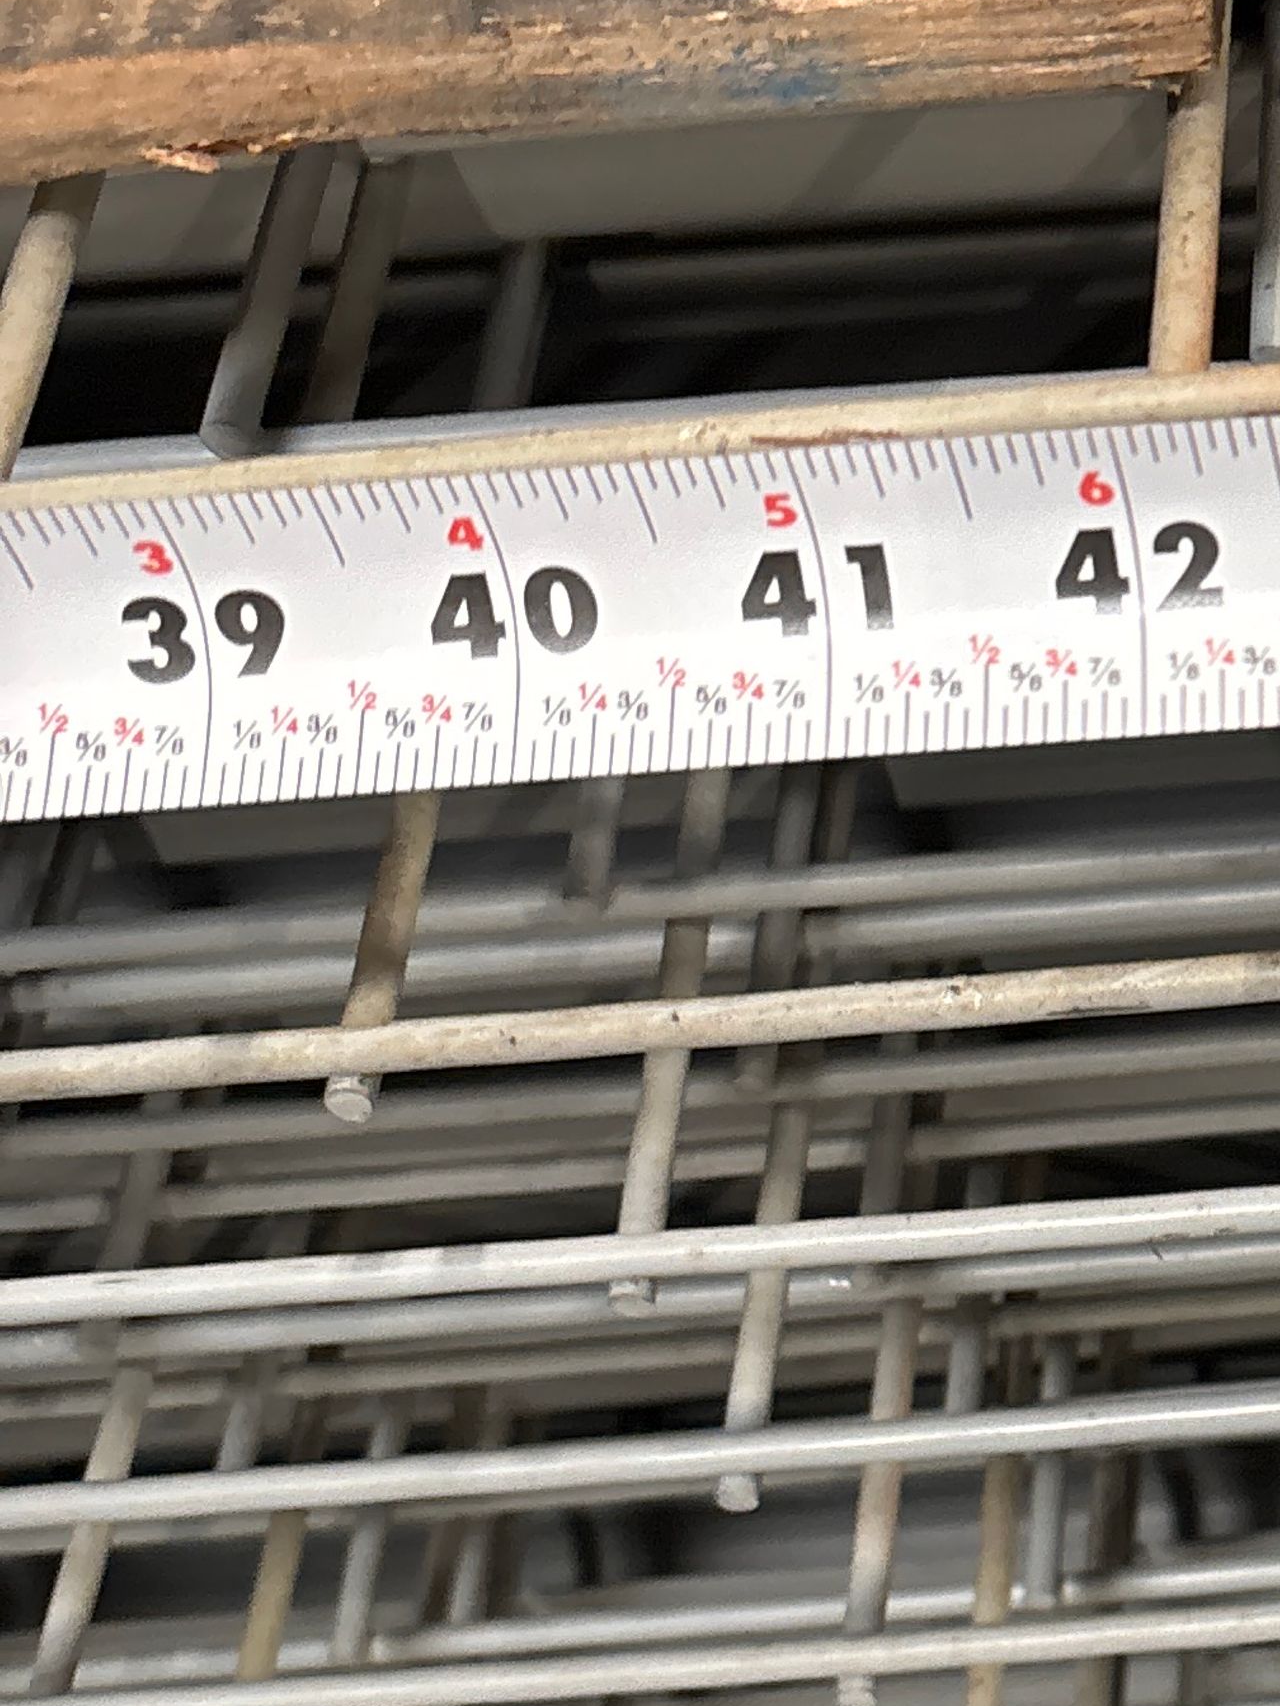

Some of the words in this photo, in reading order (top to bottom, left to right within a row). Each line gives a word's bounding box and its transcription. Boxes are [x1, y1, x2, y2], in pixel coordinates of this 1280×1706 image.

[131, 540, 174, 575] 3
[447, 516, 485, 552] 4
[763, 492, 798, 528] 5
[1078, 470, 1116, 507] 6
[120, 589, 286, 684] 39
[429, 565, 599, 660] 40
[741, 543, 895, 638] 41
[1054, 521, 1226, 615] 42
[37, 703, 70, 736] 1/2
[113, 716, 146, 748] 3/4
[270, 706, 299, 737] 1/4
[347, 679, 378, 710] 1/2
[420, 693, 453, 724] 3/4
[578, 683, 608, 712] 1/4
[655, 657, 687, 688] 1/2
[730, 671, 764, 702] 3/4
[892, 659, 922, 690] 1/4
[969, 633, 1001, 665] 1/2
[1043, 647, 1079, 678] 3/4
[1205, 637, 1236, 667] 1/4
